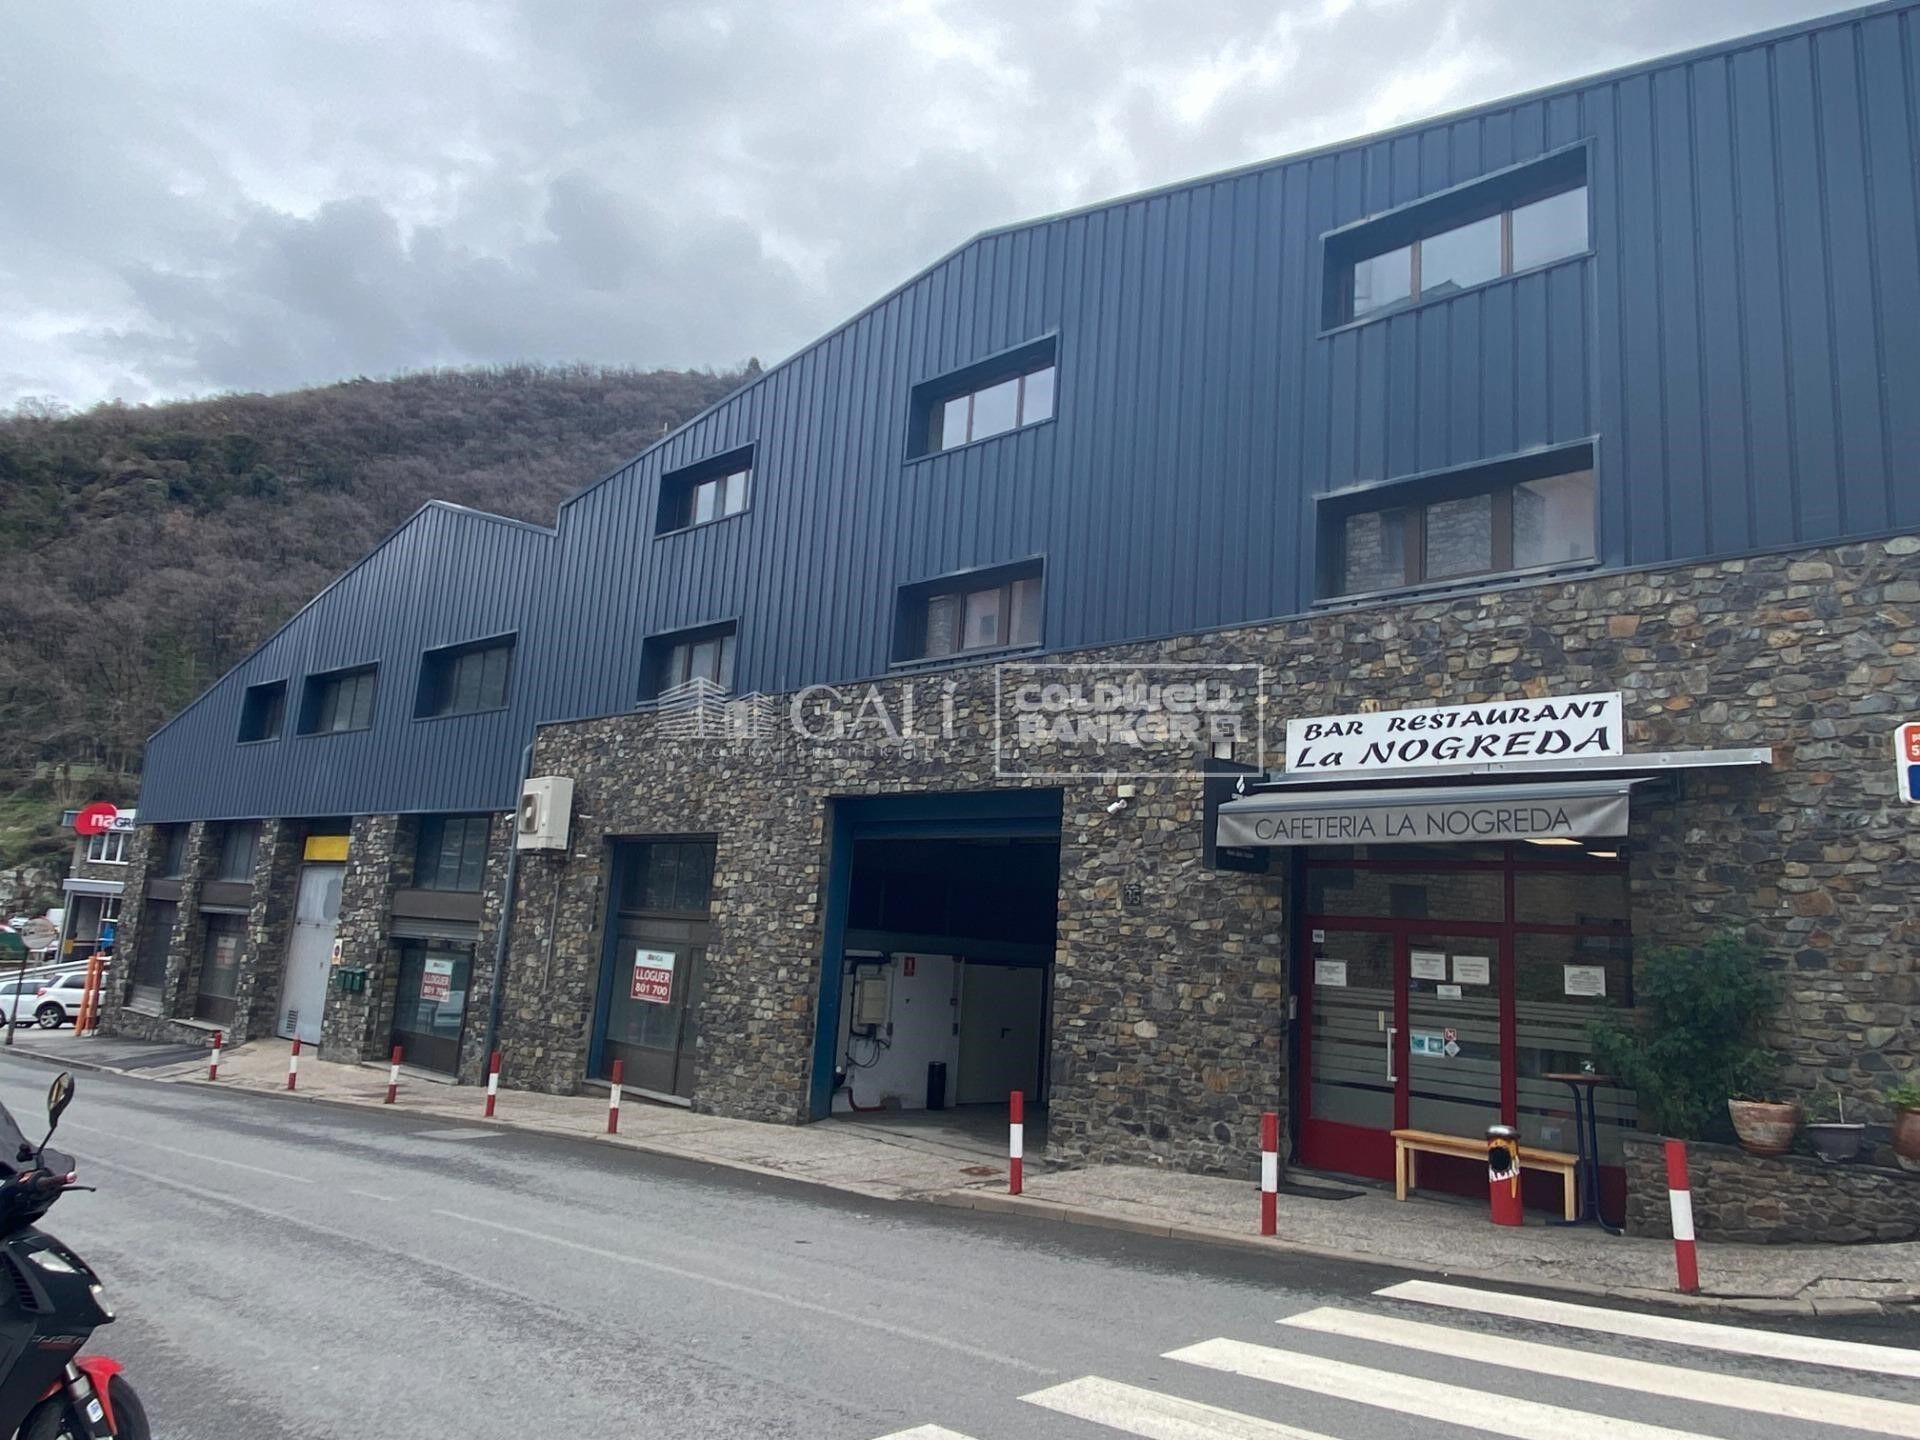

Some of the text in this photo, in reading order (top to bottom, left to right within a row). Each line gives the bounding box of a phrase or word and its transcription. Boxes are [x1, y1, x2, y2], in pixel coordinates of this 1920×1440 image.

[1304, 700, 1609, 741] BAR RESTAURANT
[1358, 727, 1611, 765] NOGREDA
[1255, 807, 1572, 840] CAFETERIA LA NOGREDA
[635, 968, 670, 983] LLOGUER
[635, 982, 650, 993] 801
[652, 985, 668, 997] 700
